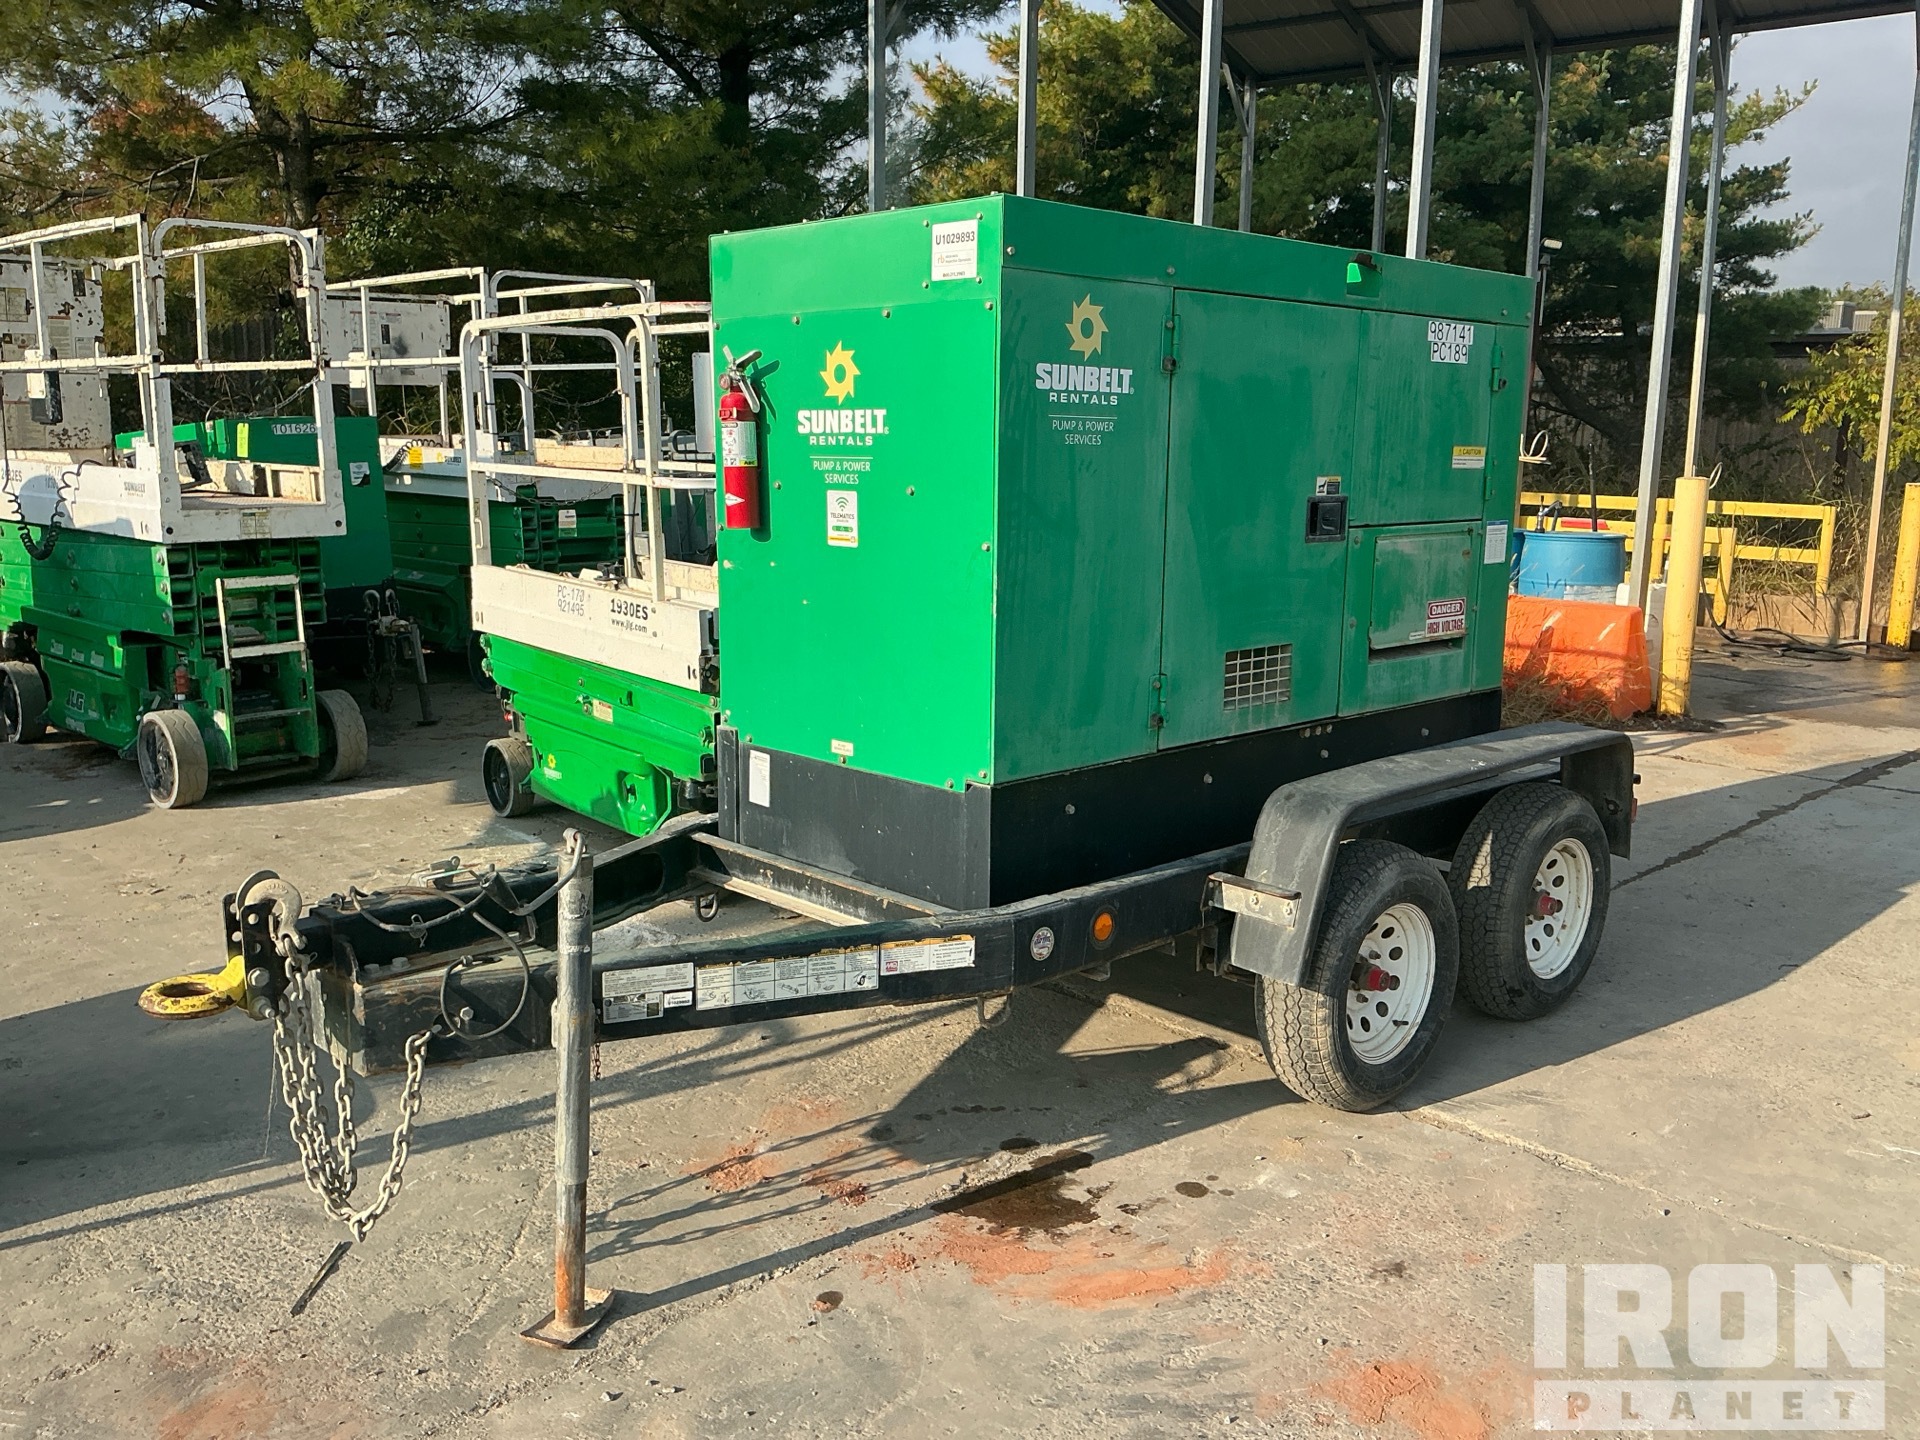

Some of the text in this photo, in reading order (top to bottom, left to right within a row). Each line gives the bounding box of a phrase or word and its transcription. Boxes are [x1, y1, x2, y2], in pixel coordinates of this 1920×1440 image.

[935, 231, 976, 246] U1029893
[1429, 321, 1472, 344] 987141
[1432, 342, 1469, 363] PC189
[1034, 362, 1134, 394] SUNBELT
[1049, 392, 1118, 406] RENTALS
[797, 408, 888, 435] SUNBELT
[1052, 419, 1114, 432] PUMP & POWER
[809, 435, 874, 446] RENTALS
[1064, 433, 1102, 446] SERVICES
[1462, 447, 1482, 456] CAUTION
[813, 460, 871, 472] PUMP & POWER
[824, 473, 860, 485] SERVICES
[829, 512, 855, 521] TELEMATICS
[557, 599, 586, 616] 921495
[609, 598, 649, 621] 1930ES
[1430, 603, 1462, 616] DANGER
[610, 617, 649, 633] www.jlg.com
[1426, 618, 1465, 635] HIGH VOLTAGE
[66, 688, 86, 713] JLG
